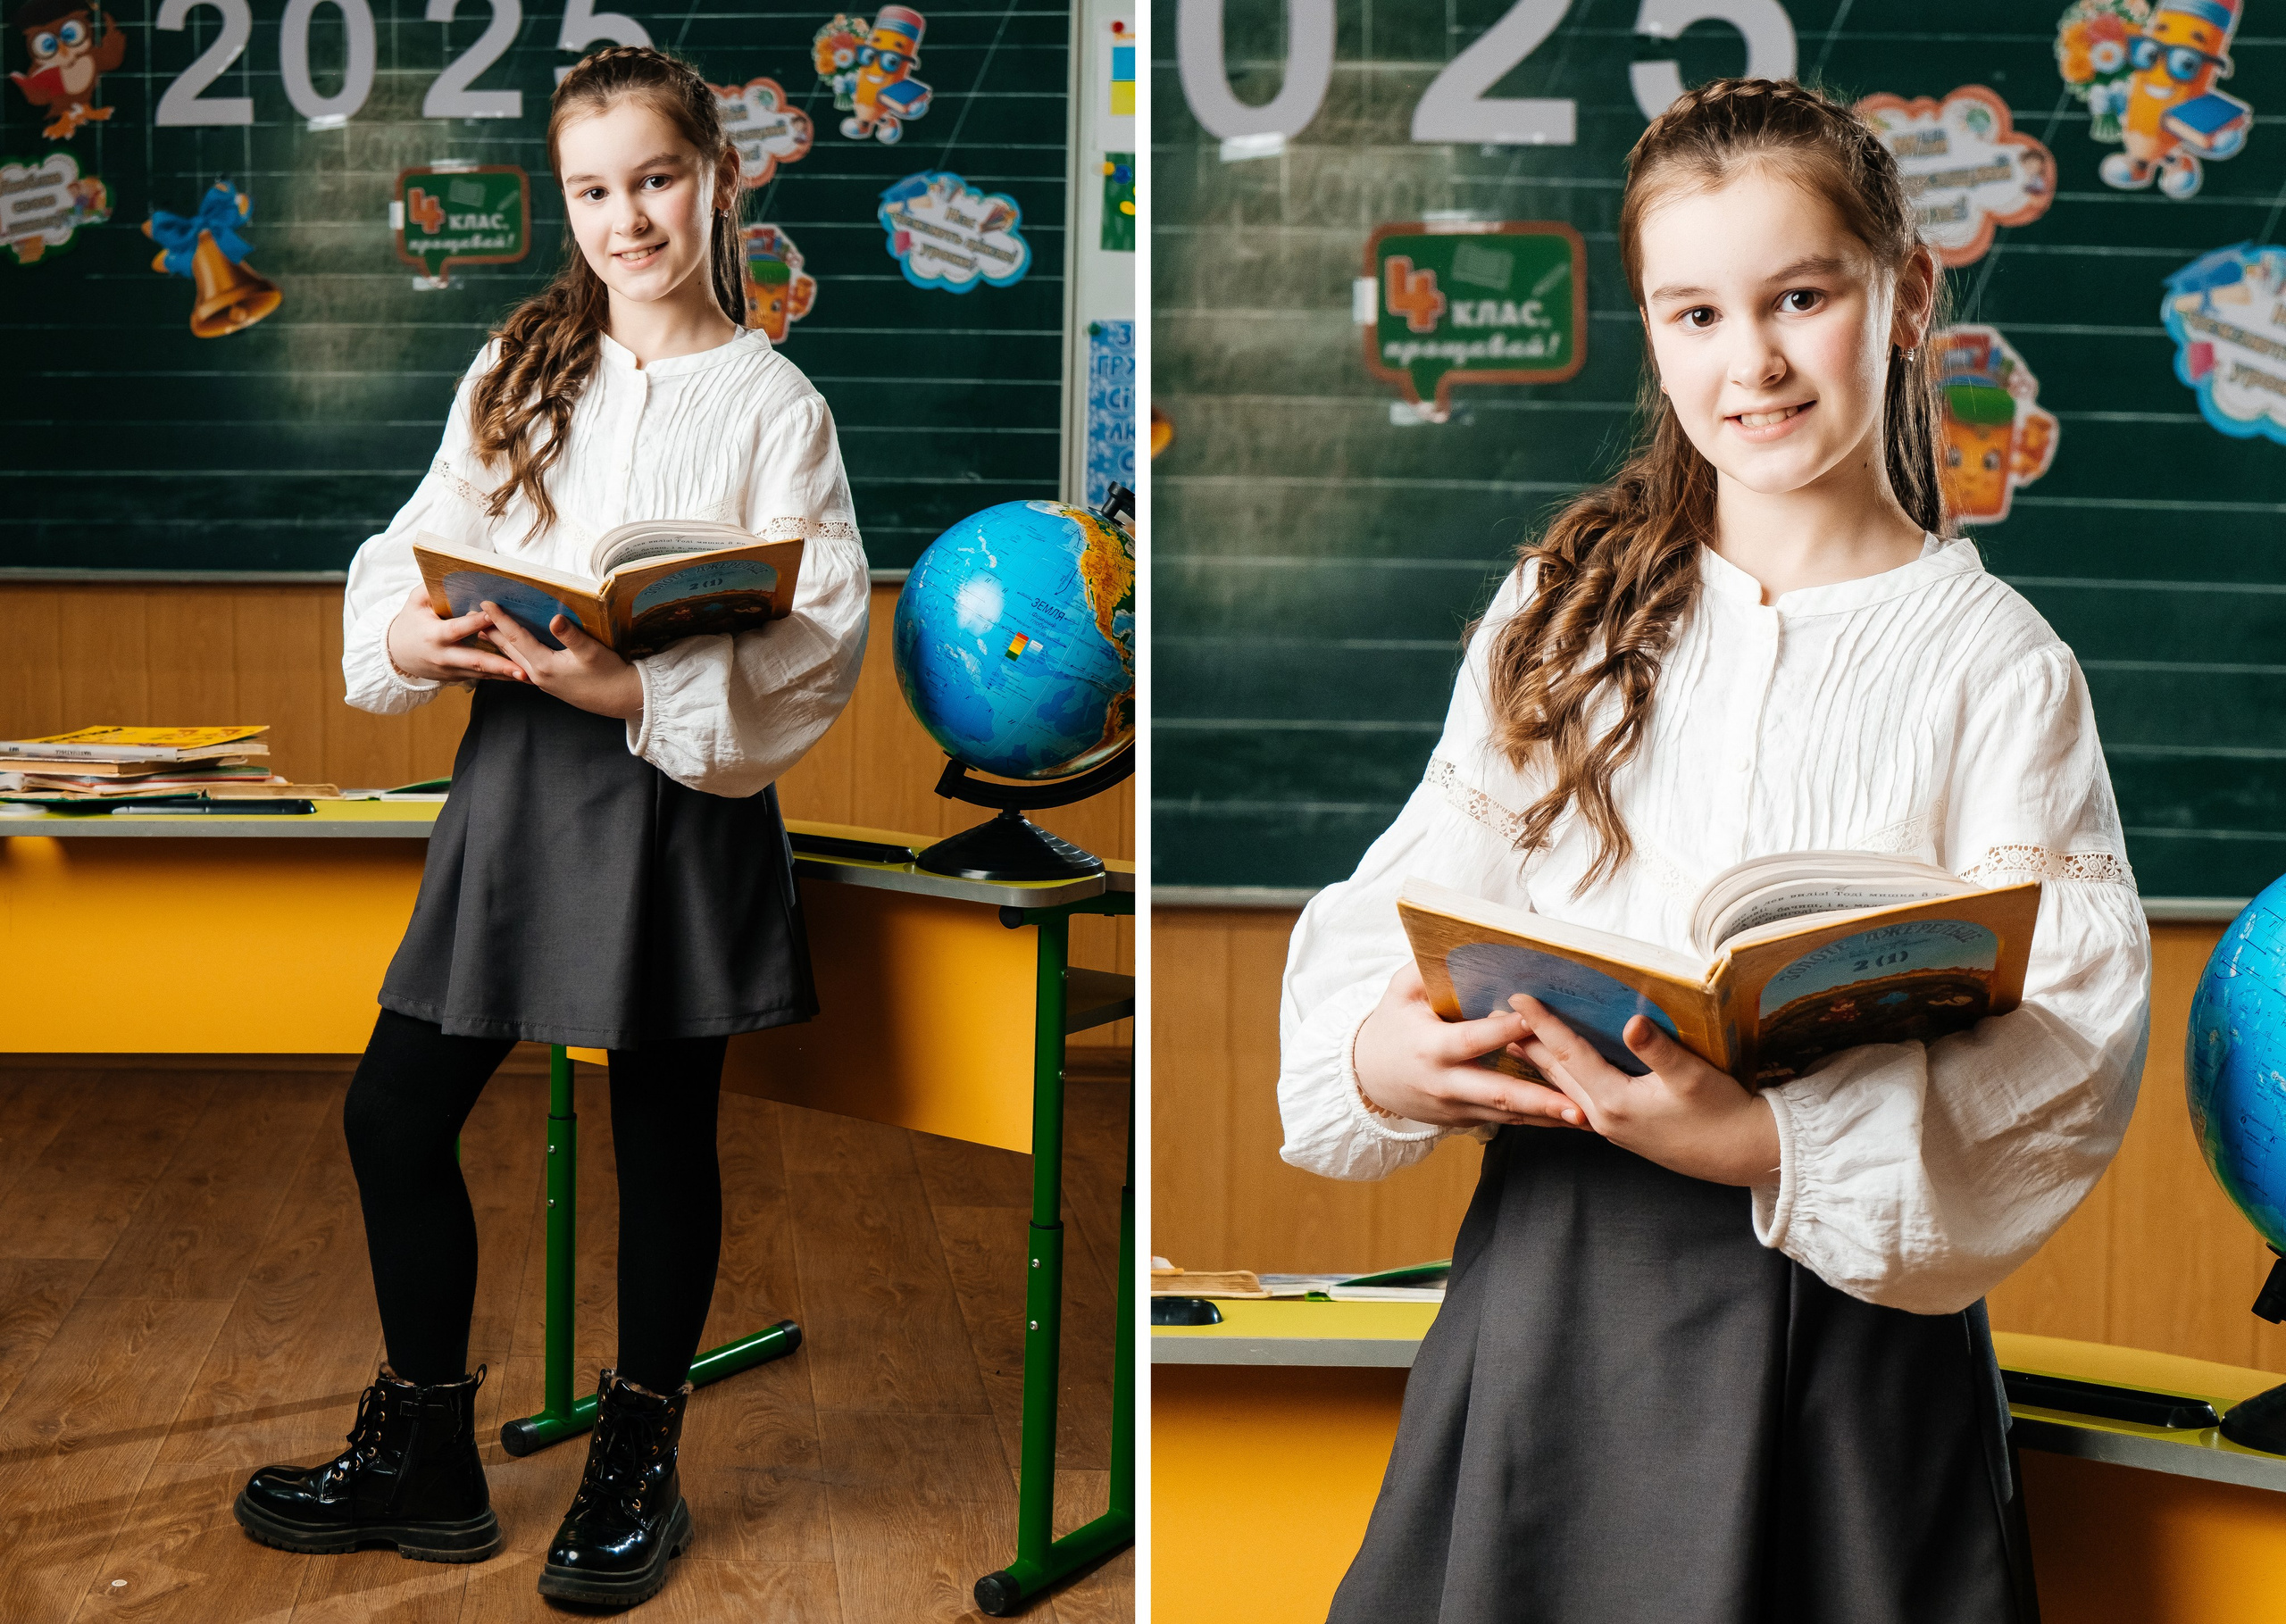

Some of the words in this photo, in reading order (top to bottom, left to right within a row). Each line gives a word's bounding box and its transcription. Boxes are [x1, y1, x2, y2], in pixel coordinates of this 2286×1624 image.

[408, 187, 446, 234] 4
[448, 212, 510, 230] КЛАС,
[1385, 255, 1446, 332] 4
[1451, 298, 1552, 329] КЛАС,
[1384, 333, 1562, 367] прощавай!
[1030, 597, 1066, 622] ЗЕМЛЯ
